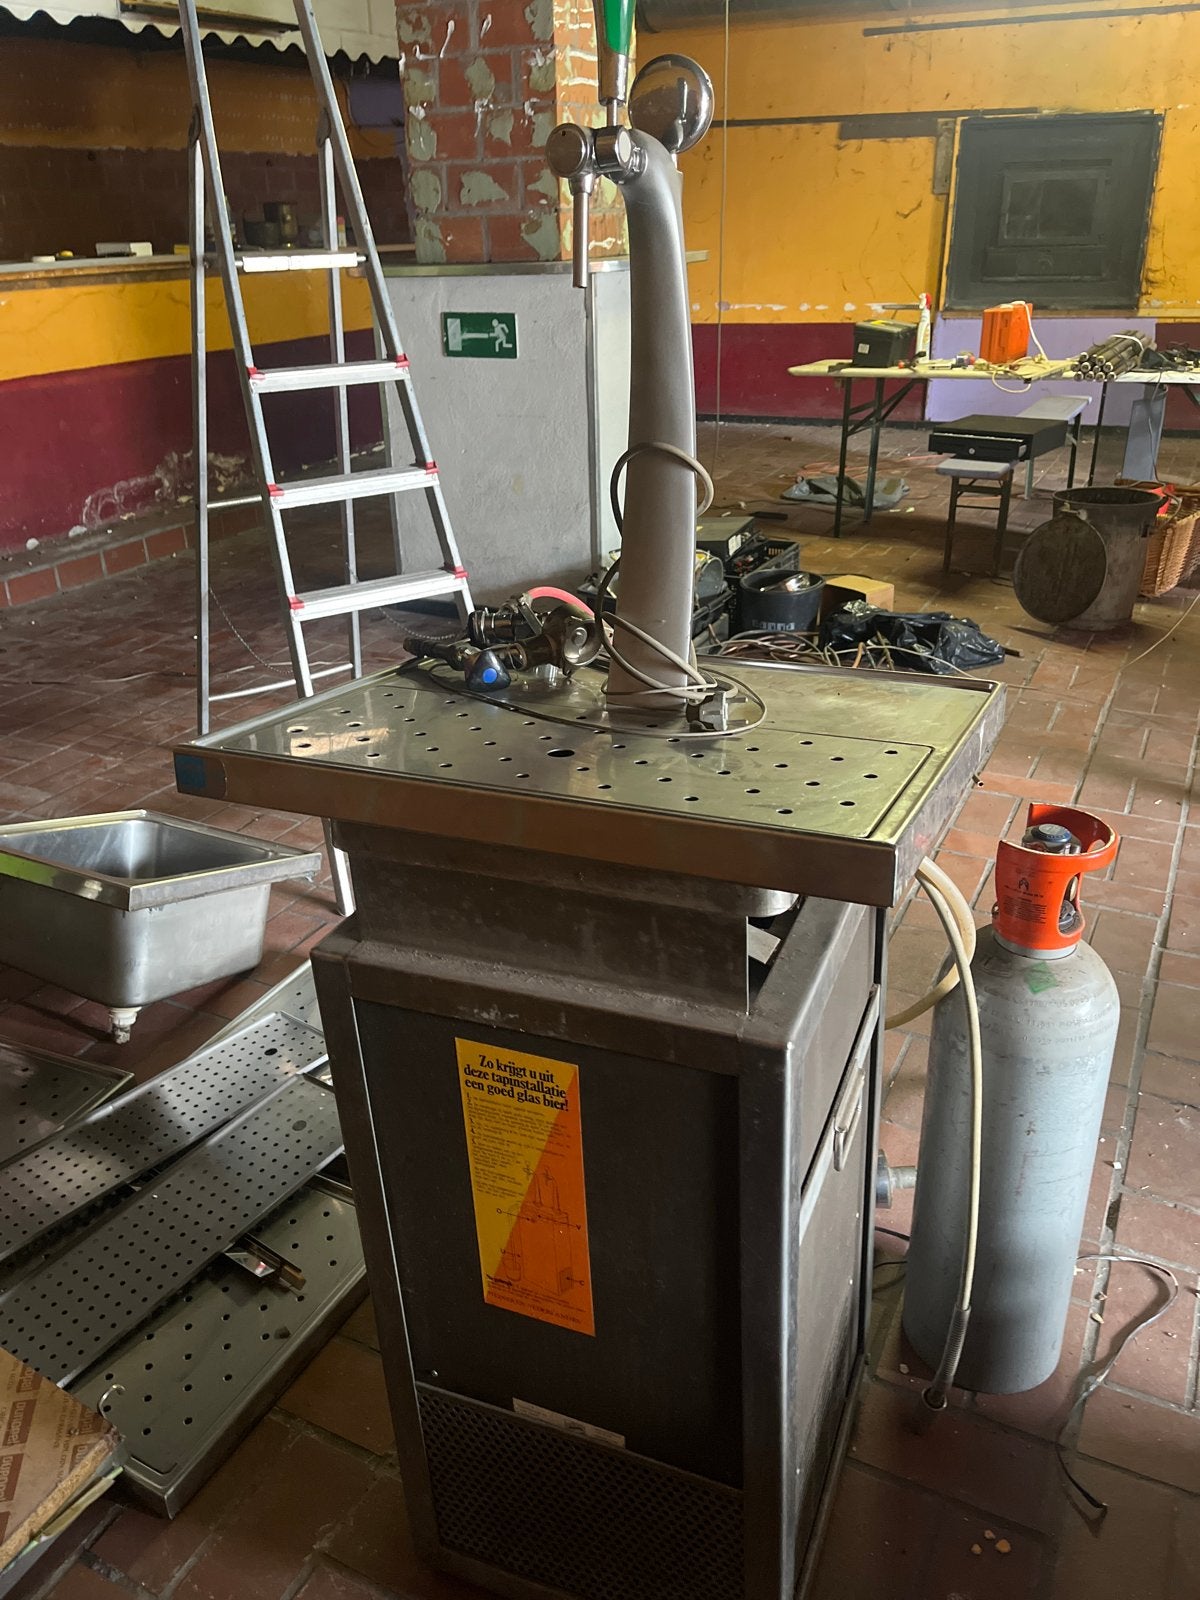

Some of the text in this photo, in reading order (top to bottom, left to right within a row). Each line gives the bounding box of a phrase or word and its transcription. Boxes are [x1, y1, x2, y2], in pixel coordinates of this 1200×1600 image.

[463, 1064, 567, 1099] deze tapinstallatie
[478, 1055, 555, 1084] Zo krijgt u uit
[464, 1079, 486, 1092] een
[487, 1083, 515, 1099] goed
[516, 1089, 542, 1104] glas
[543, 1094, 569, 1112] bier!
